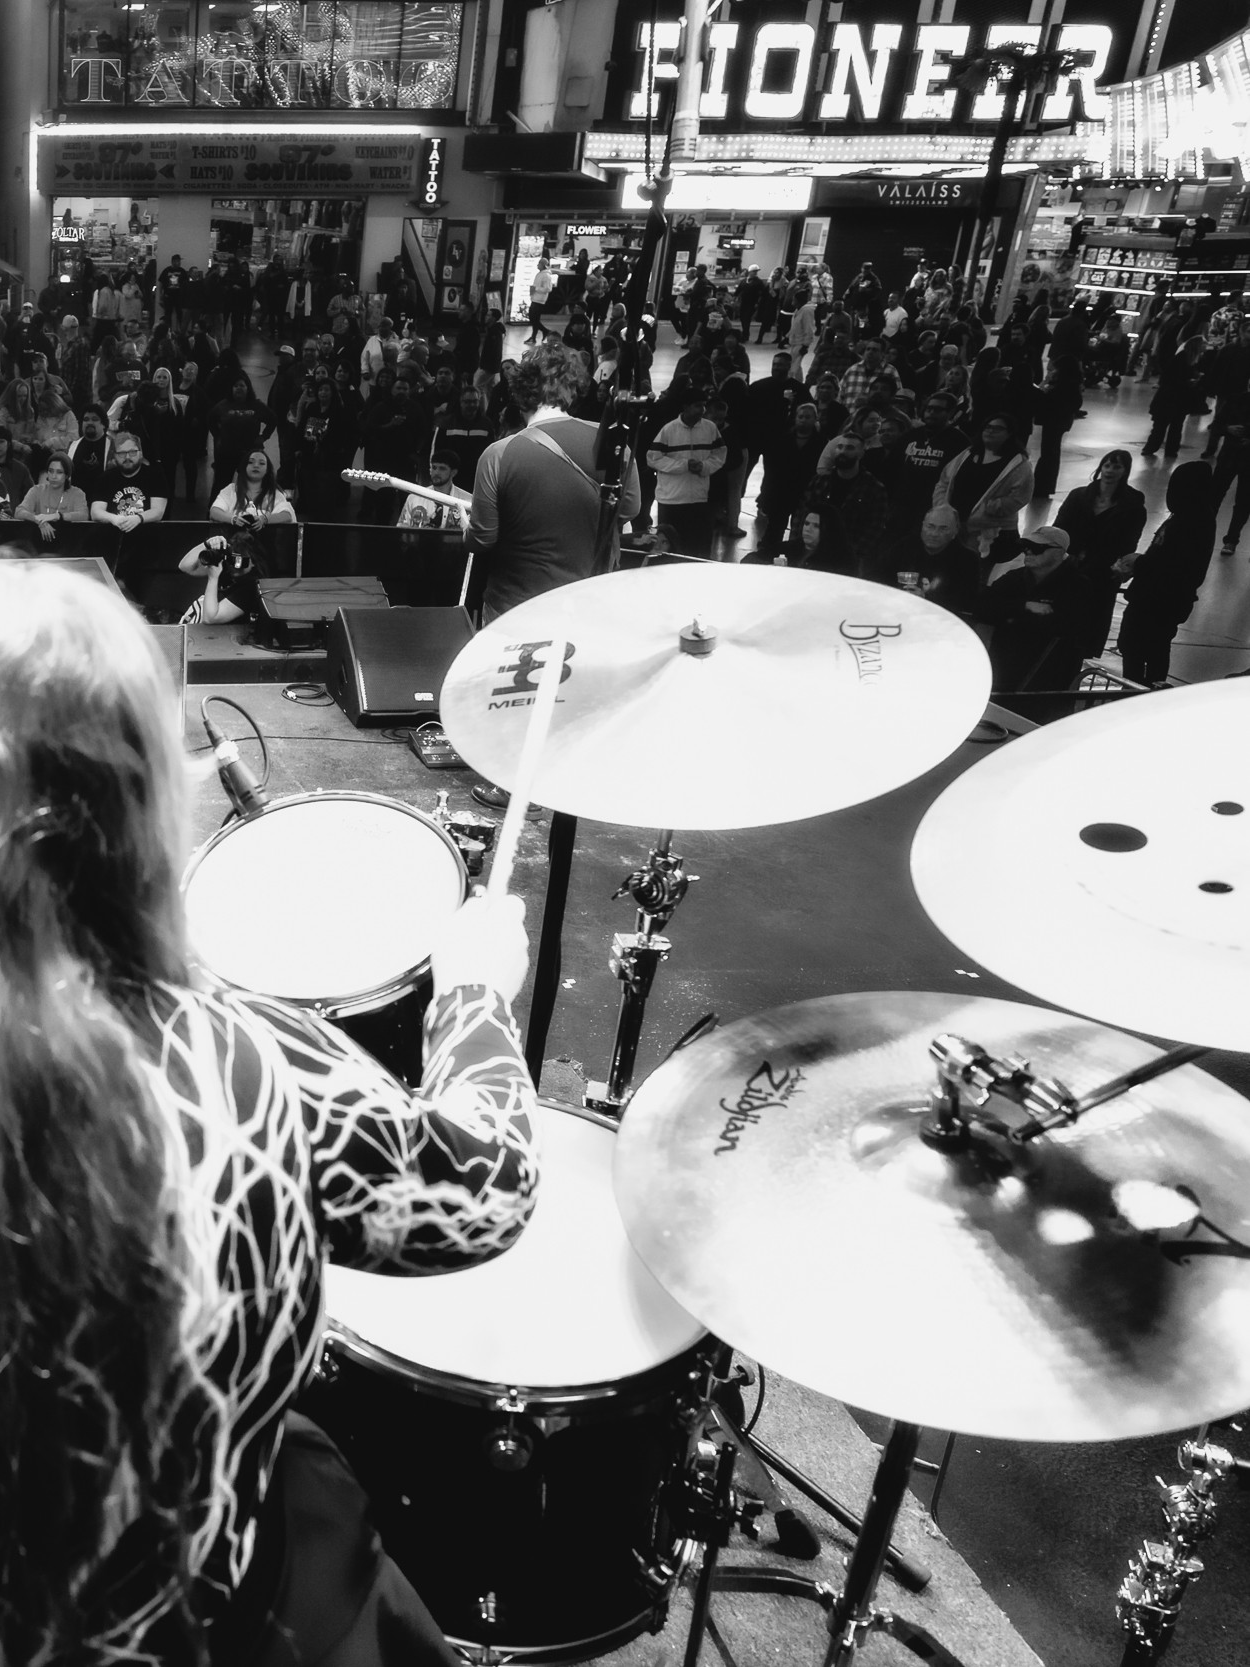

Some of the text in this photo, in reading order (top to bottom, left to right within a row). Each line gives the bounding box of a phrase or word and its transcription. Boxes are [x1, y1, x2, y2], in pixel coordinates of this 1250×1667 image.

[628, 21, 1113, 122] PIONEER
[69, 57, 453, 104] TATTOO
[191, 145, 257, 160] T-SHIRTS $10
[354, 146, 398, 159] KEYCHAINS
[189, 165, 234, 181] HATS $10
[368, 165, 414, 181] WATER $1
[425, 138, 441, 204] TATTOO
[677, 214, 696, 228] 25
[51, 226, 85, 241] ZOLTAR
[566, 225, 607, 235] FLOWER
[488, 696, 566, 711] MEIL
[713, 1060, 790, 1157] Zildjian
